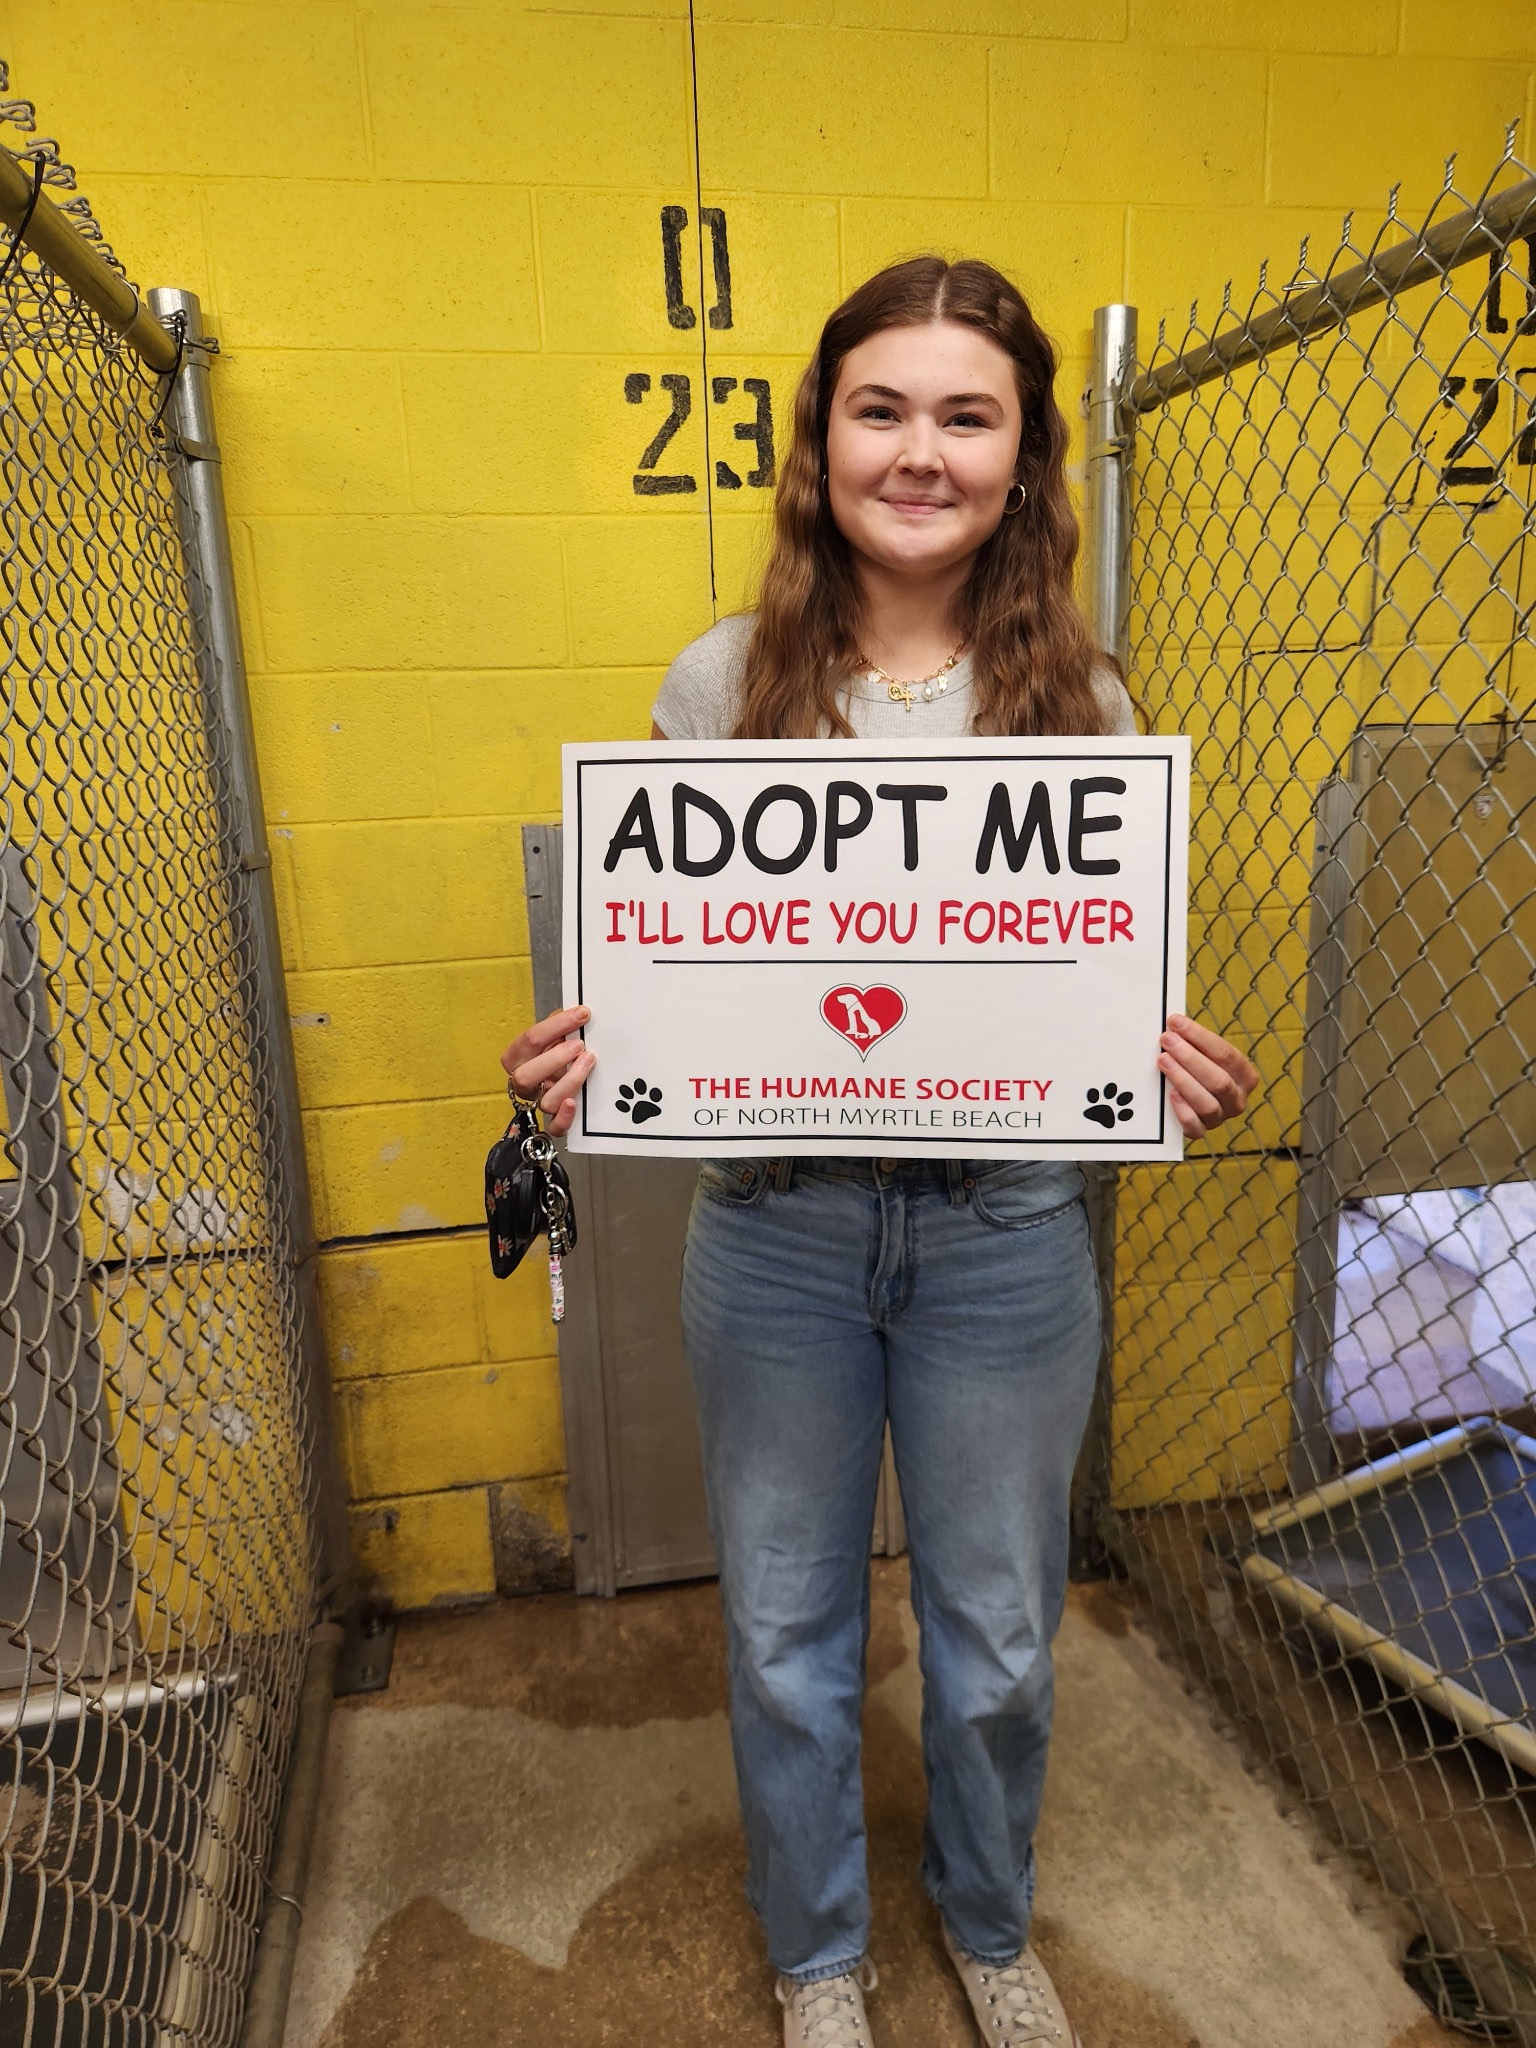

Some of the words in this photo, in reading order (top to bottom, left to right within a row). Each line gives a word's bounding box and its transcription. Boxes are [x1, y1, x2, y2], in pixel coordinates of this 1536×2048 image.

[624, 373, 776, 496] 23
[604, 781, 947, 877] ADOPT
[976, 777, 1126, 875] ME
[606, 900, 683, 944] I'LL
[703, 900, 810, 945] LOVE
[829, 902, 917, 944] YOU
[940, 899, 1134, 945] FOREVER
[689, 1078, 750, 1098] THE
[762, 1078, 906, 1099] HUMANE
[917, 1079, 1052, 1100] SOCIETY
[694, 1108, 729, 1126] OF
[739, 1107, 830, 1125] NORTH
[840, 1108, 943, 1127] MYRTLE
[953, 1110, 1041, 1128] BEACH
